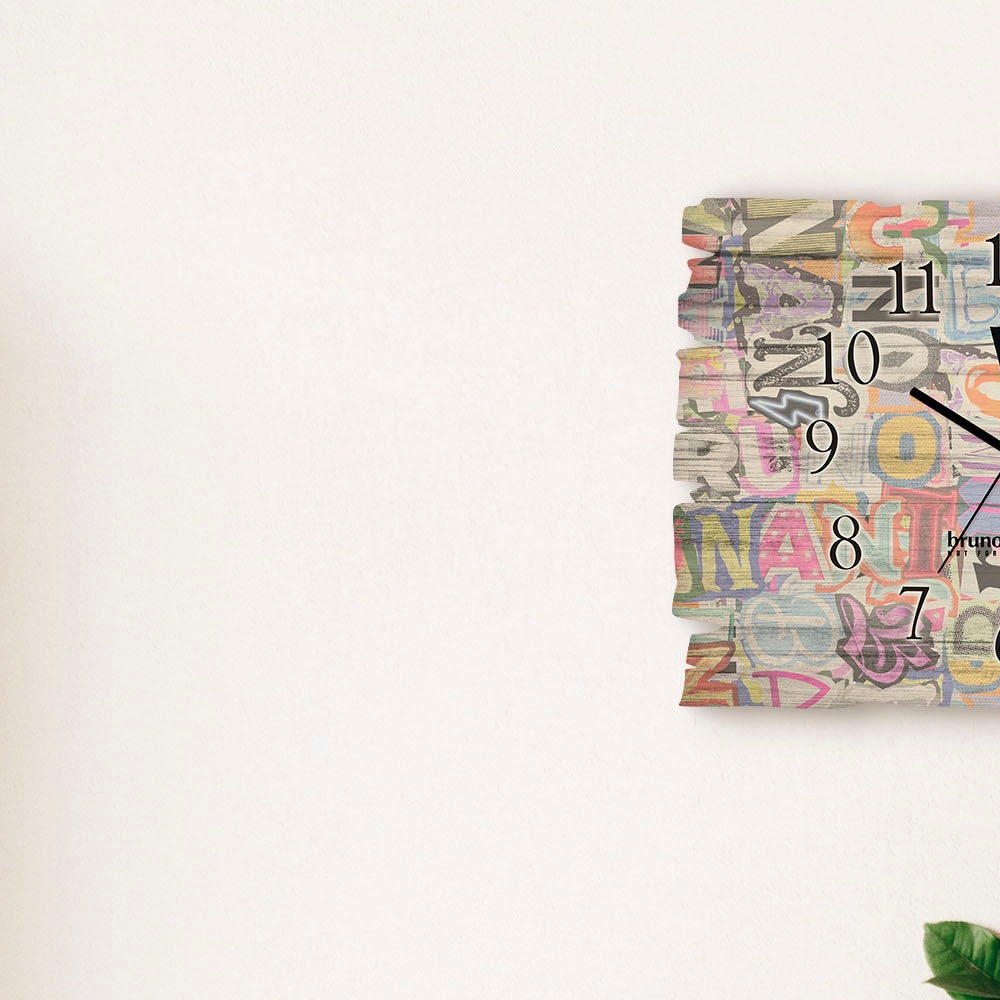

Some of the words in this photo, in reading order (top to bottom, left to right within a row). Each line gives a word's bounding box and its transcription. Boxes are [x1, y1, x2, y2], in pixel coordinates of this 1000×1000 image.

[888, 260, 941, 315] 11
[817, 330, 880, 385] 10
[806, 420, 838, 475] 9
[829, 515, 862, 570] 8
[899, 586, 930, 640] 7
